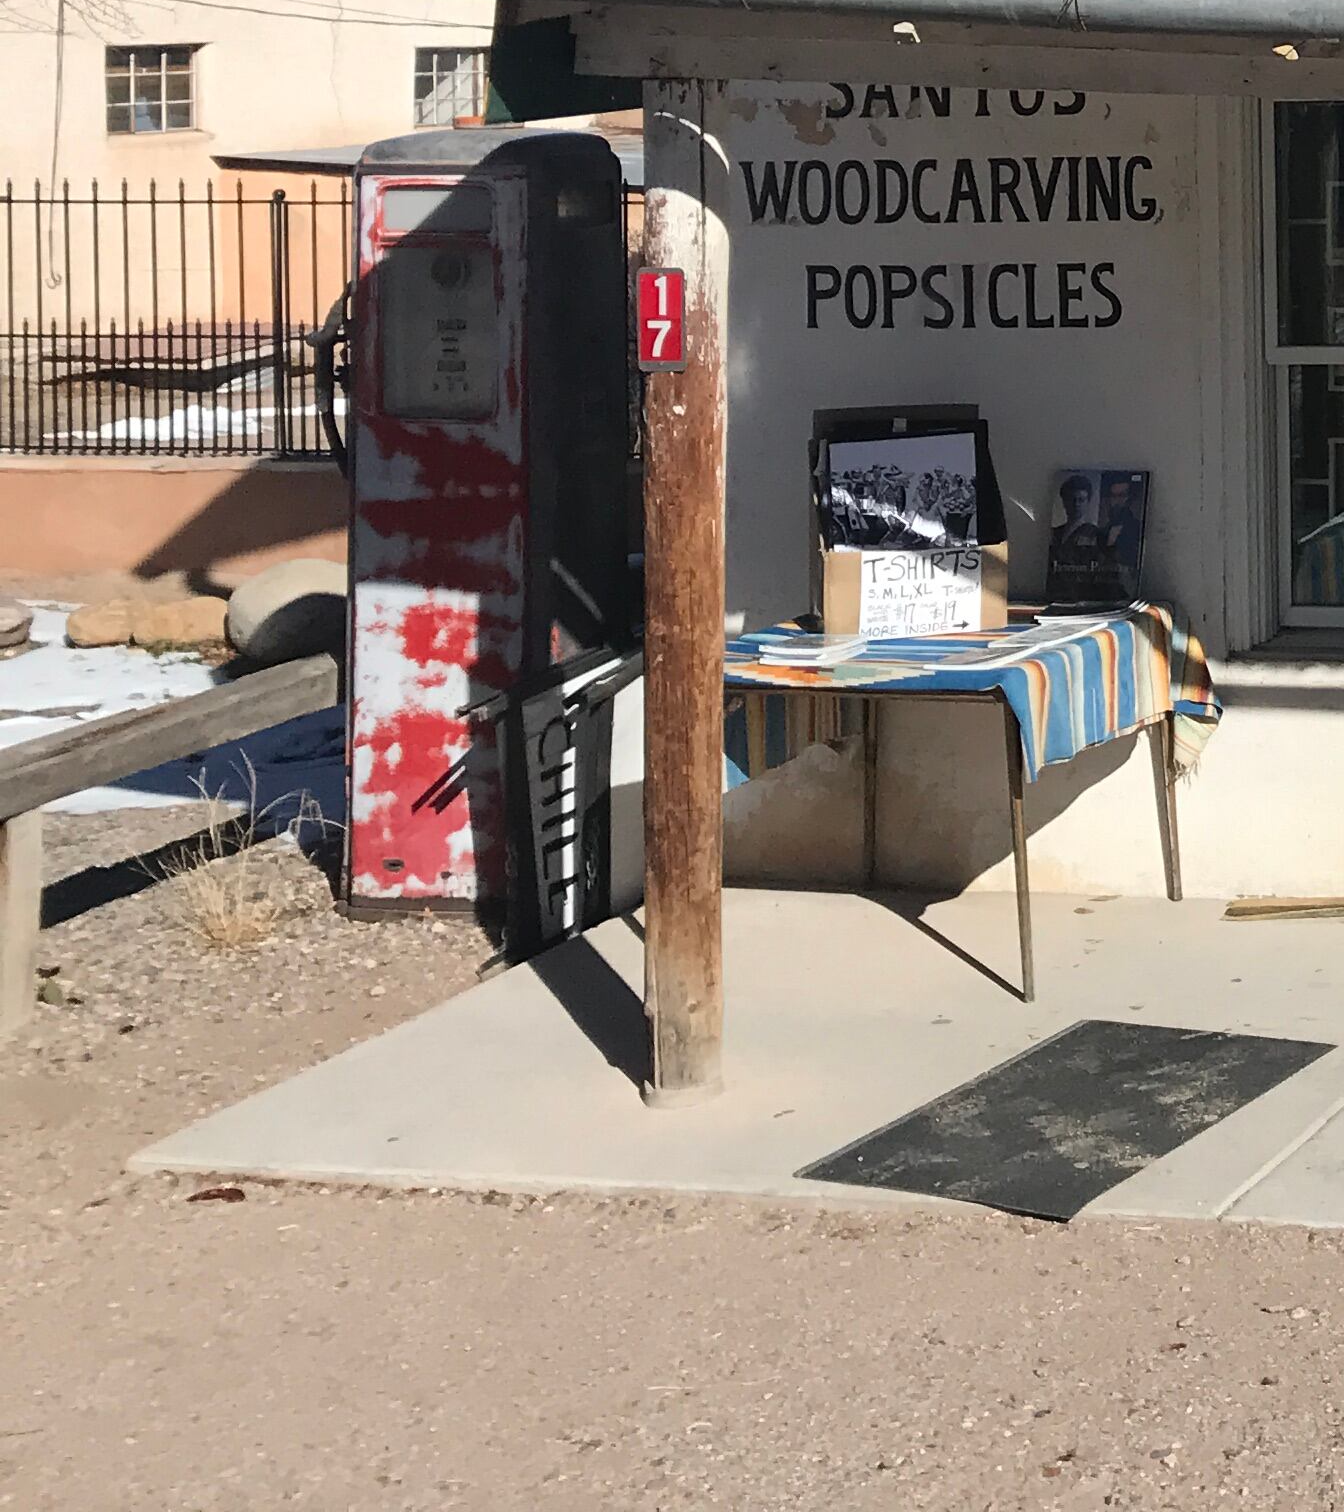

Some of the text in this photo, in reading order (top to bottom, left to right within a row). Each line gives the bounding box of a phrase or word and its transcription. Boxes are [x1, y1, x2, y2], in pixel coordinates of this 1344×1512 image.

[805, 262, 1123, 330] POPSICLES
[863, 548, 980, 583] T-SHIRTS
[860, 621, 949, 638] MORE INSIDE
